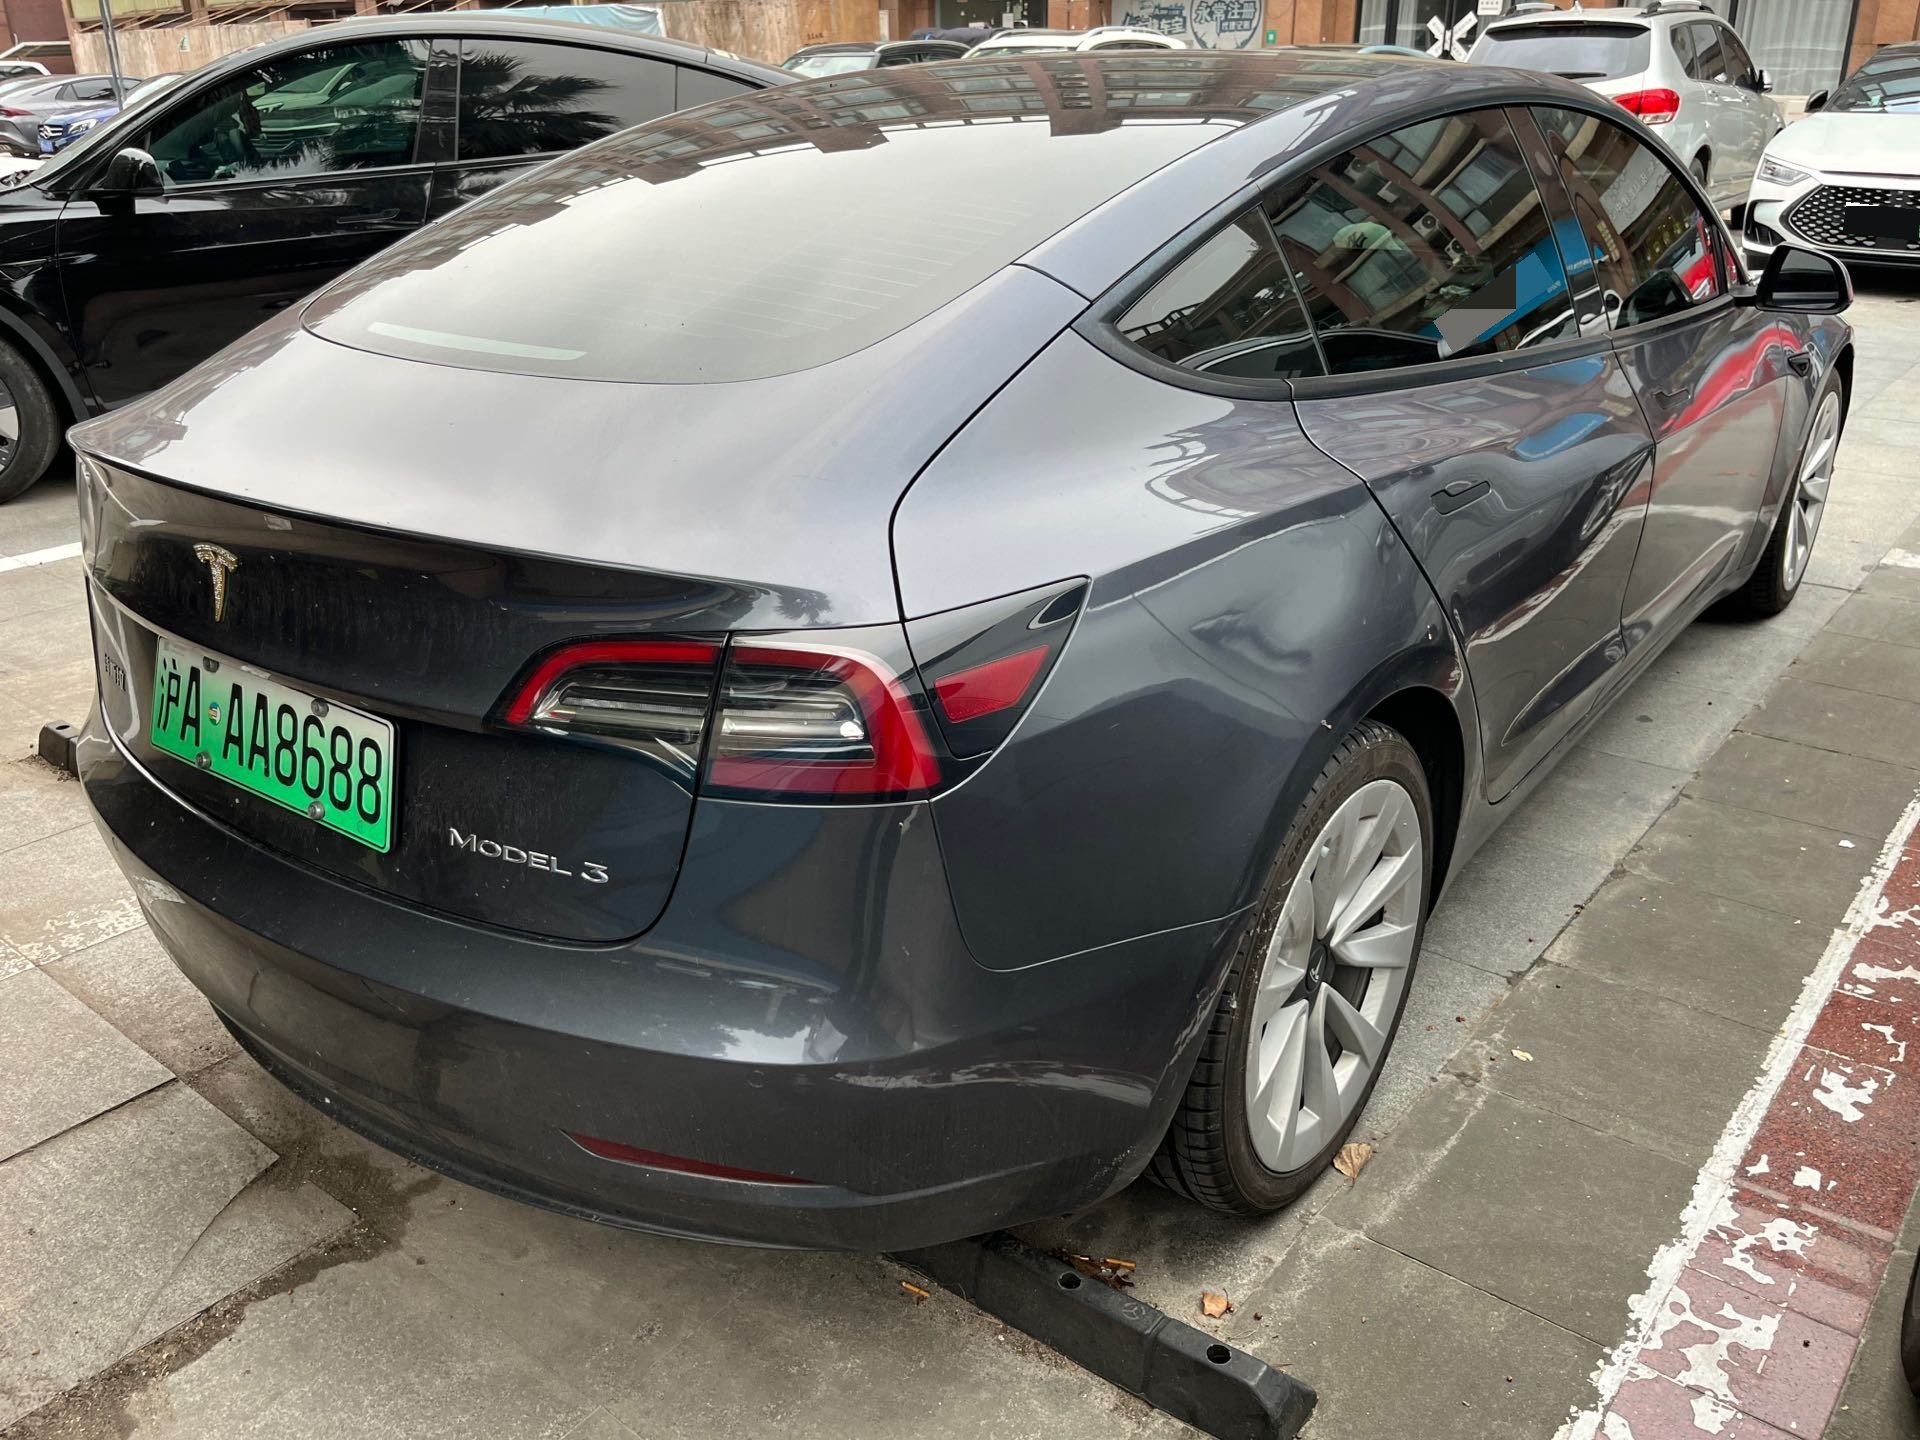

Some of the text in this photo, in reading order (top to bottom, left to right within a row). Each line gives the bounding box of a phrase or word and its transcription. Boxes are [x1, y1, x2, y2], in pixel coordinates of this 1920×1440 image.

[157, 657, 382, 825] 沪A AA8688
[449, 827, 609, 884] MODEL 3
